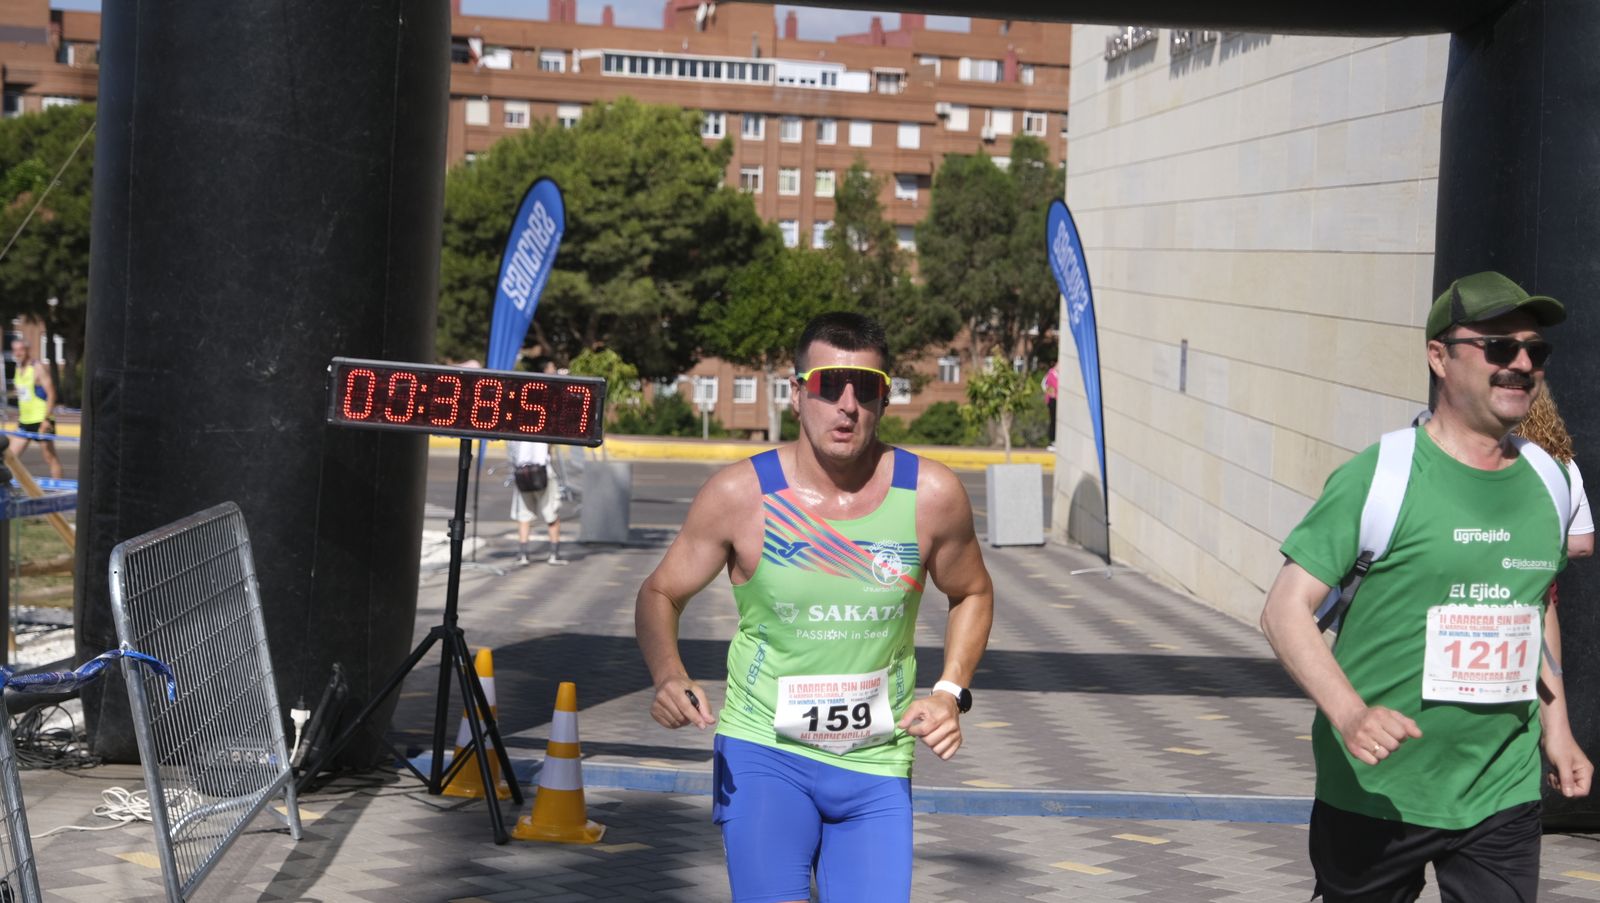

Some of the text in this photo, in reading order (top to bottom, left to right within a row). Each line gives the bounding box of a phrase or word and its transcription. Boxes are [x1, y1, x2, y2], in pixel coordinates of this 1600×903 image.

[1449, 584, 1511, 601] El Ejido
[808, 604, 904, 622] SAKATA
[851, 630, 861, 640] in
[864, 627, 889, 639] Seed
[1443, 640, 1528, 669] 1211
[802, 702, 872, 732] 159
